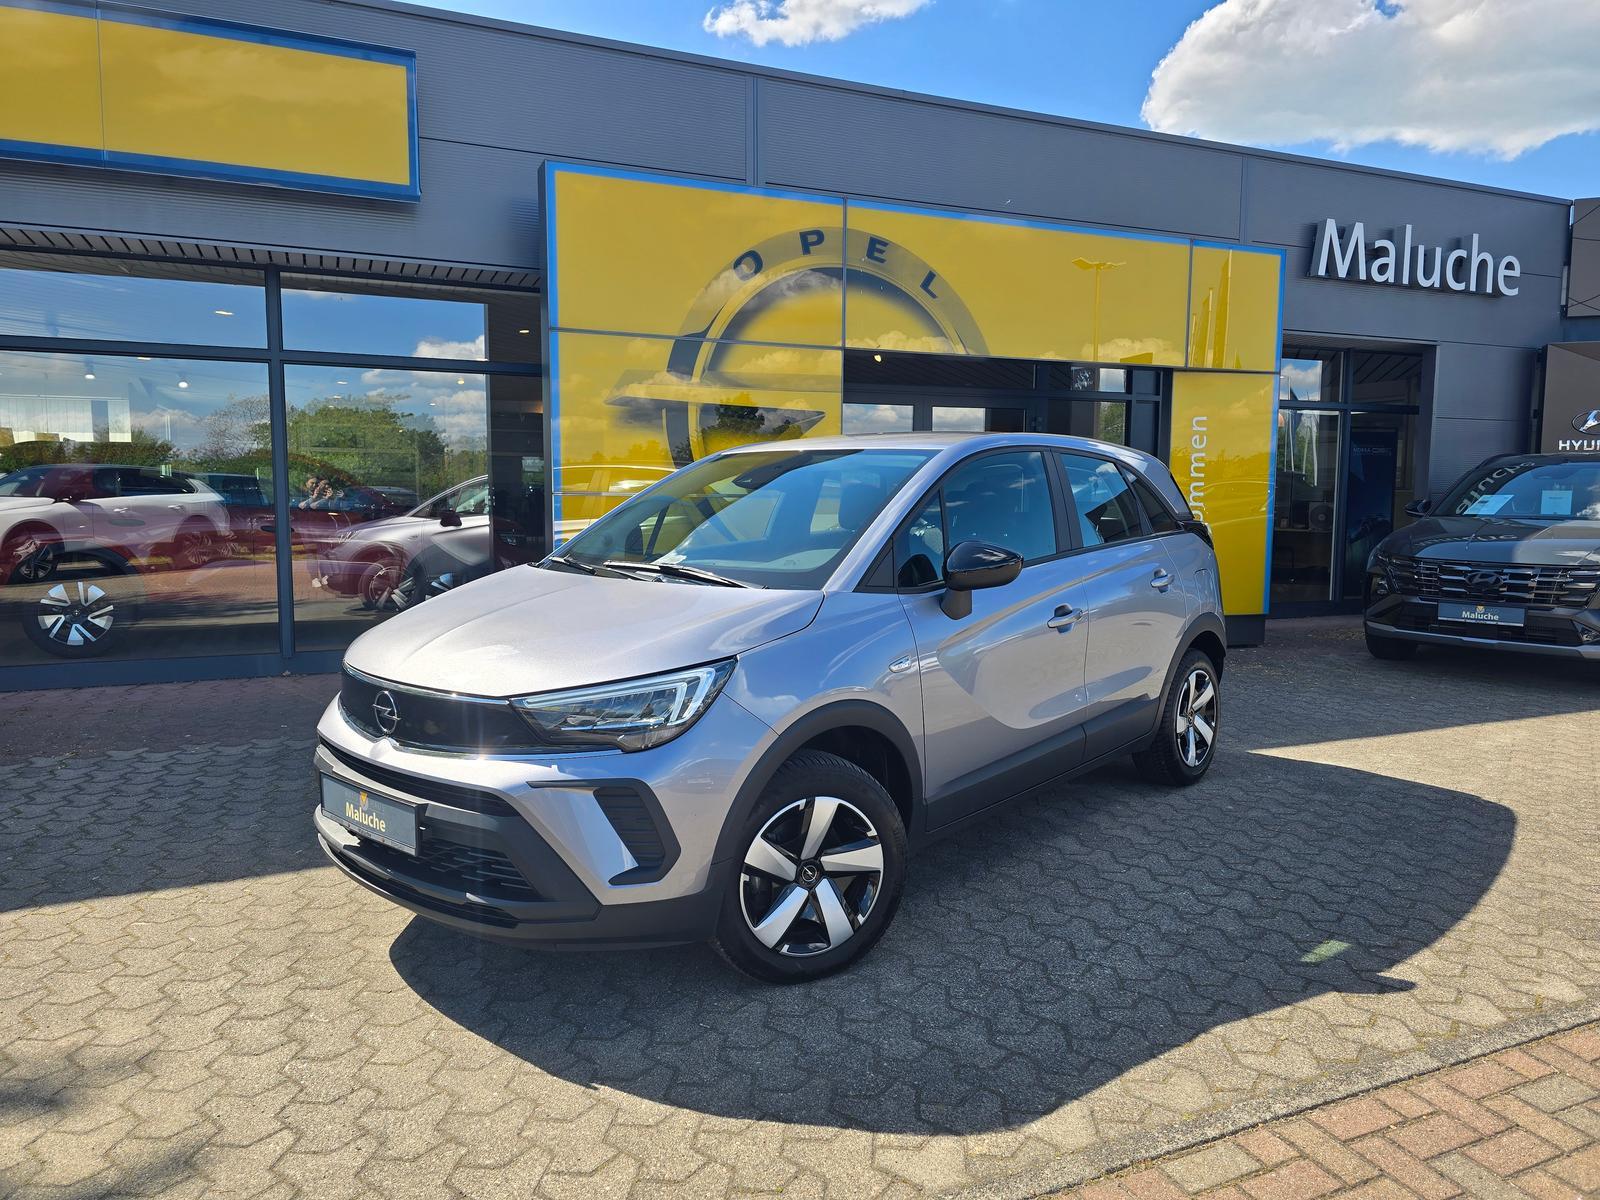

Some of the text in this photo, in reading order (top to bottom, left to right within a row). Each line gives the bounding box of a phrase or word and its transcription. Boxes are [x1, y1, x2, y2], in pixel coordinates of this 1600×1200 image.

[733, 229, 939, 299] OPEL
[1317, 218, 1521, 297] Maluche
[1461, 610, 1499, 621] Maluche
[345, 801, 386, 832] Maluche
